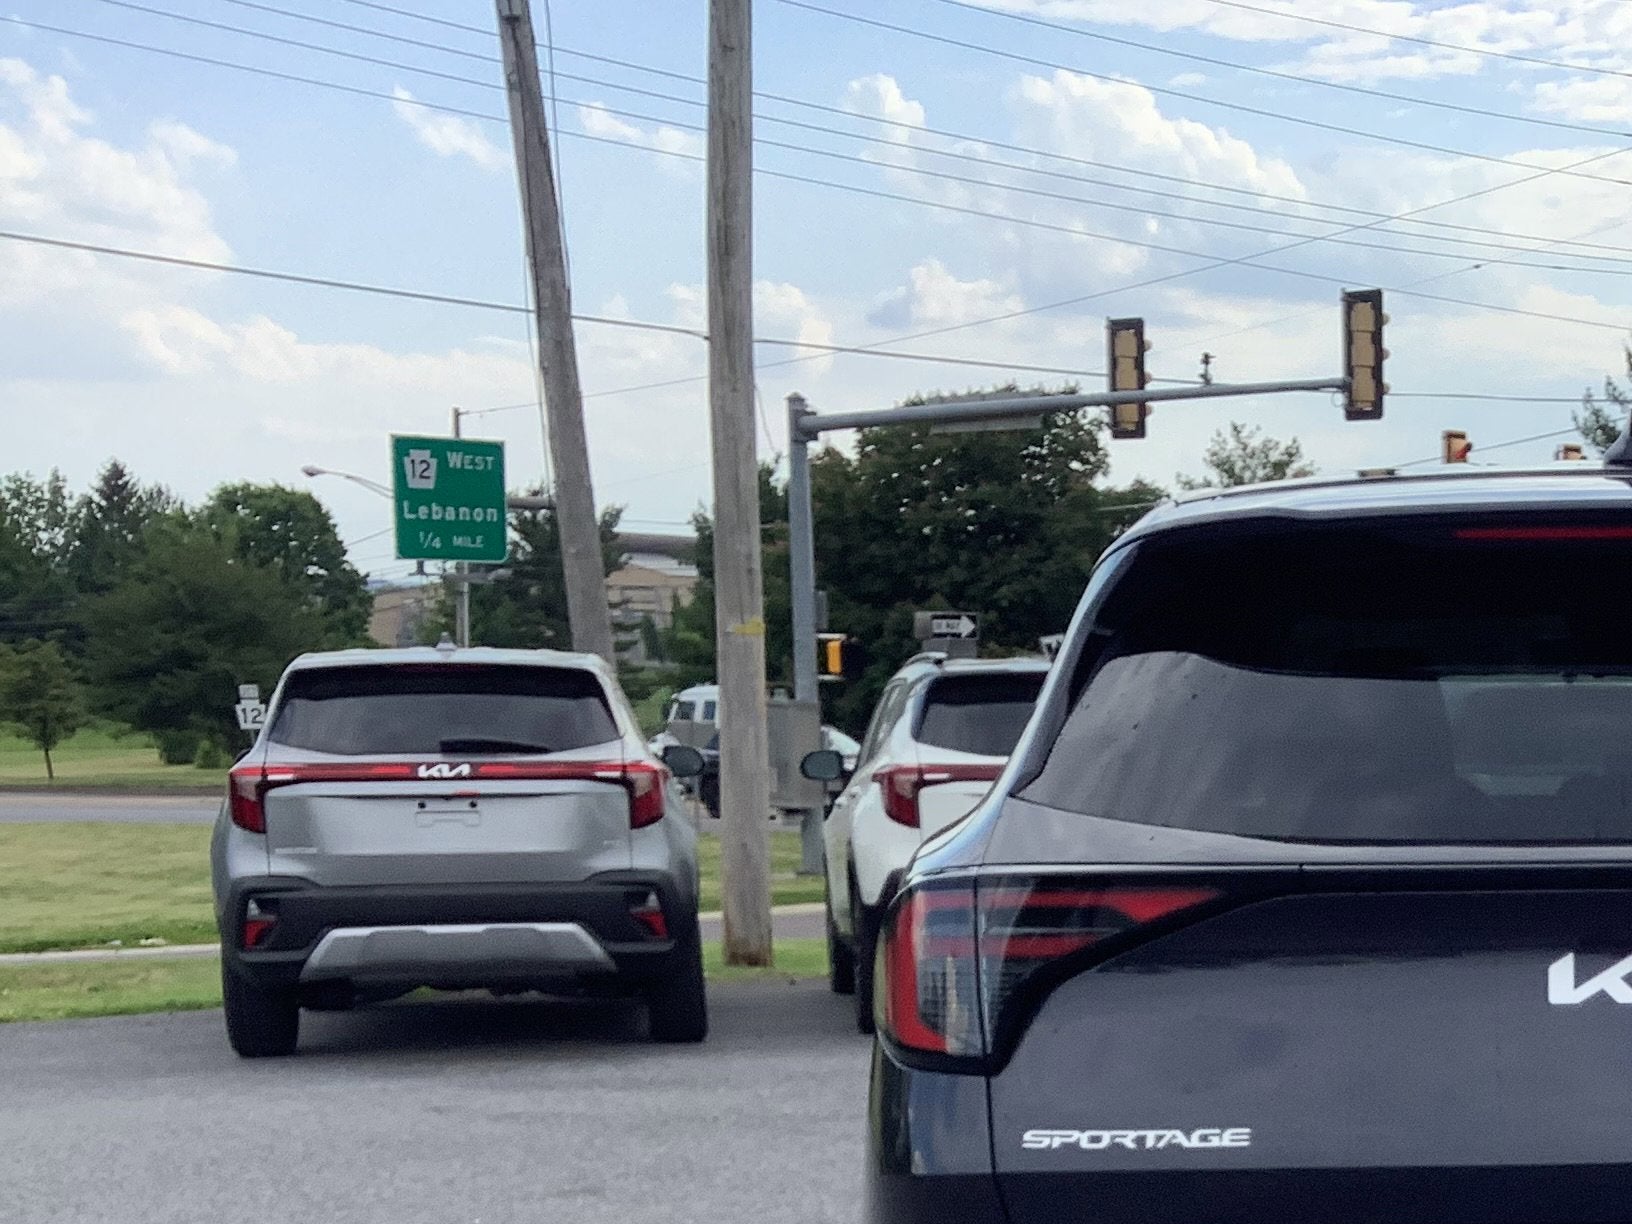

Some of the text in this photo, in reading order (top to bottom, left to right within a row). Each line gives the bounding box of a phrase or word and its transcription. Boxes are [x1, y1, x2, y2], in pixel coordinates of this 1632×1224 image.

[410, 459, 431, 480] 12
[447, 451, 495, 470] WEST
[403, 500, 498, 522] Lebanon
[453, 535, 484, 548] MILE
[241, 707, 265, 724] 12
[418, 763, 470, 777] KIA
[1022, 1128, 1252, 1149] SPORTAGE
